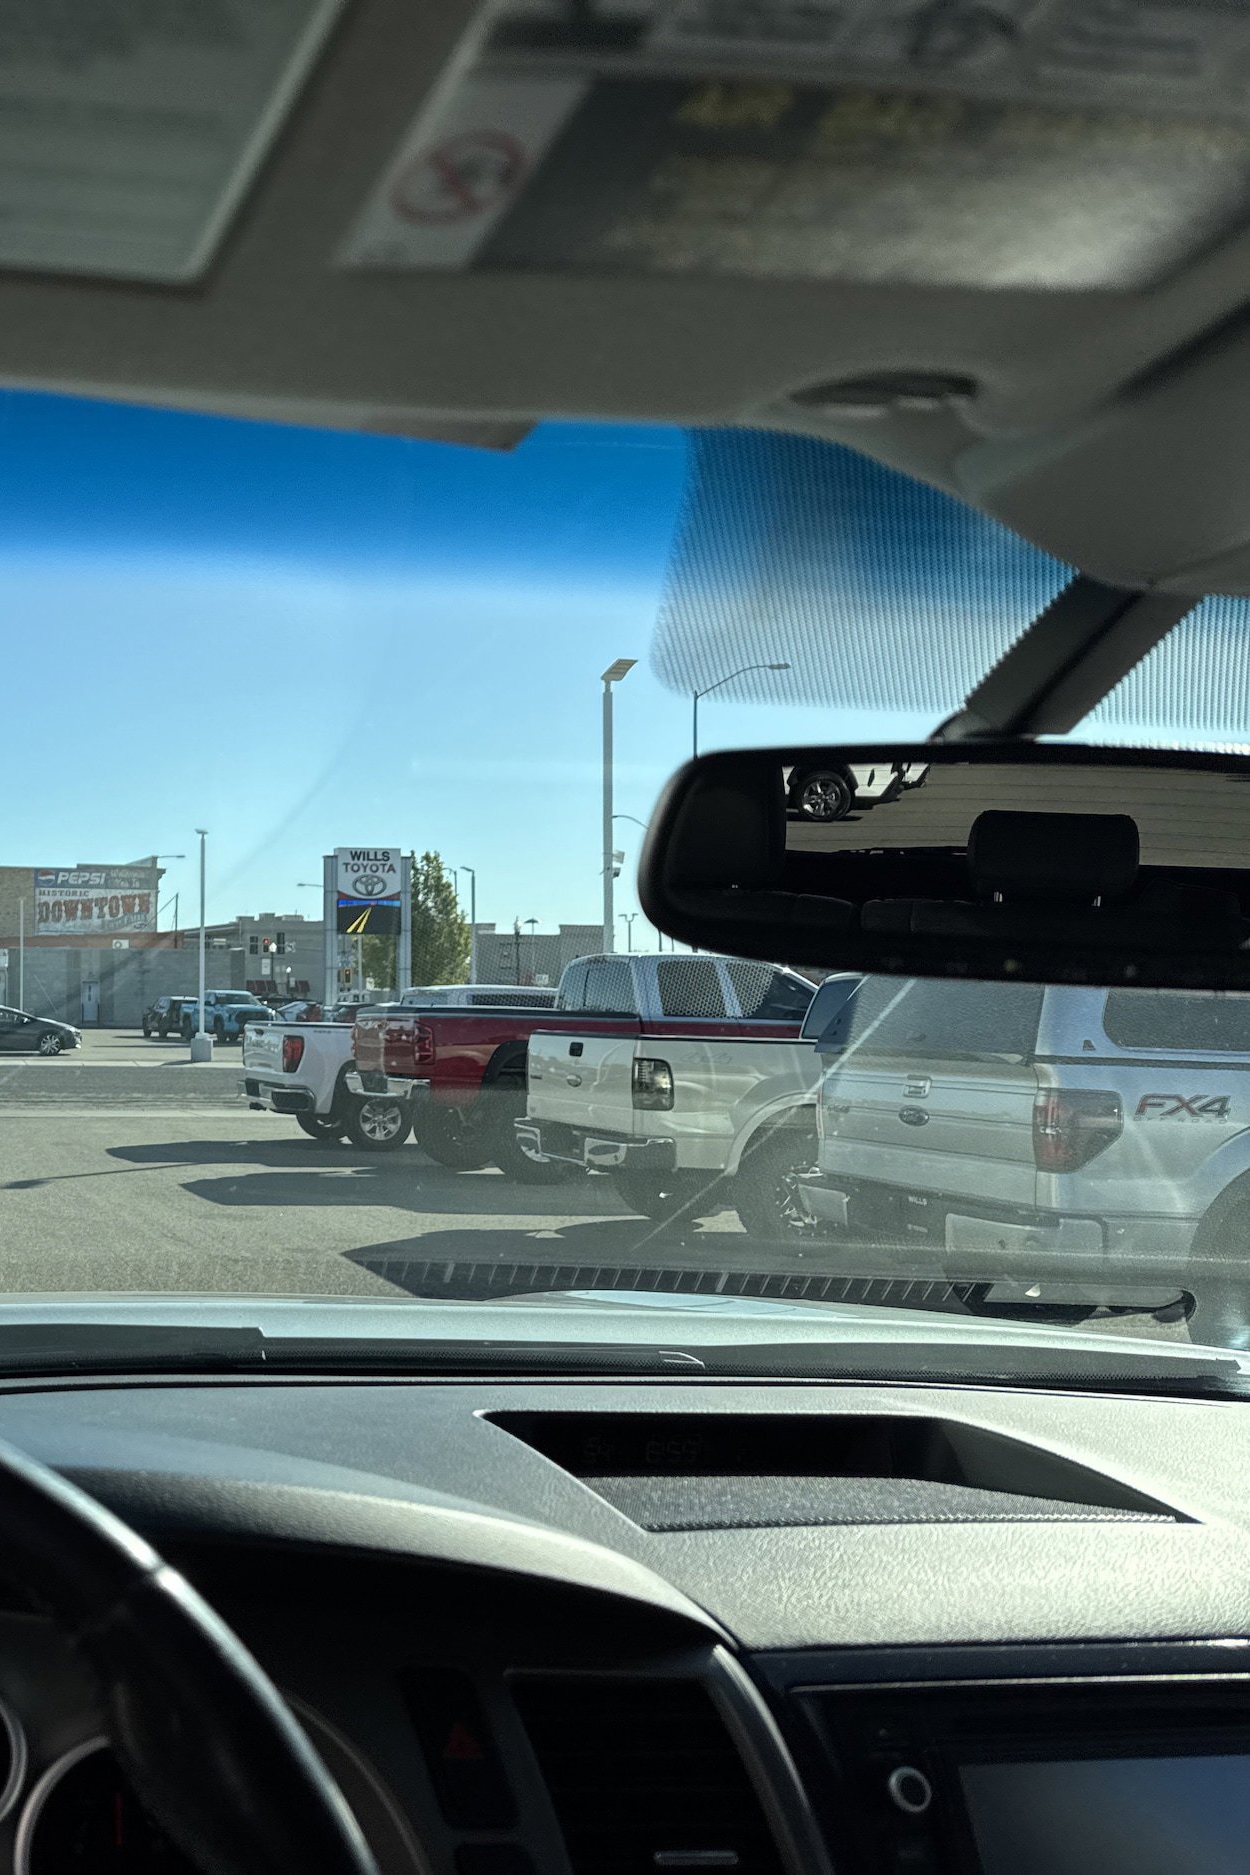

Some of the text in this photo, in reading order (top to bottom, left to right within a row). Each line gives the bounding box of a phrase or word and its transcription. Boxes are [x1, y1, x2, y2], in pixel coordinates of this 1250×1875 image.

[350, 850, 390, 861] WILLS
[343, 862, 396, 873] TOYOTA
[57, 871, 106, 884] PEPSI
[38, 889, 90, 897] HISTORIC
[37, 893, 152, 924] DOWNTOWN
[1134, 1093, 1231, 1118] FX4
